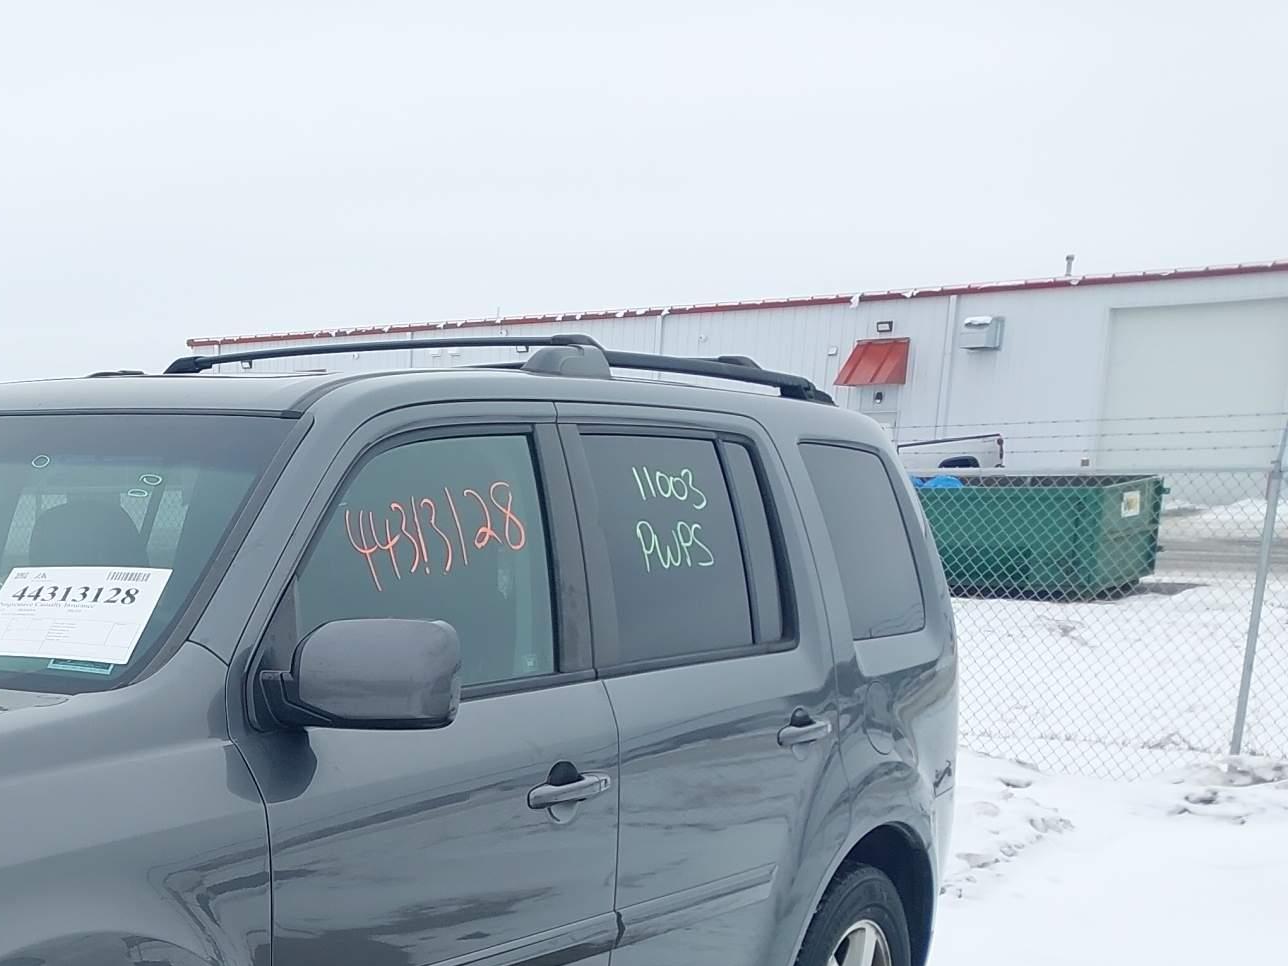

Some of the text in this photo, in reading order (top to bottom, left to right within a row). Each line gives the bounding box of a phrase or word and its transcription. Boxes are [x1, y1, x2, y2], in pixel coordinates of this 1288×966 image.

[632, 466, 707, 509] 11003
[345, 481, 526, 591] 44313128
[636, 520, 714, 572] PWPS
[12, 585, 140, 605] 44313128
